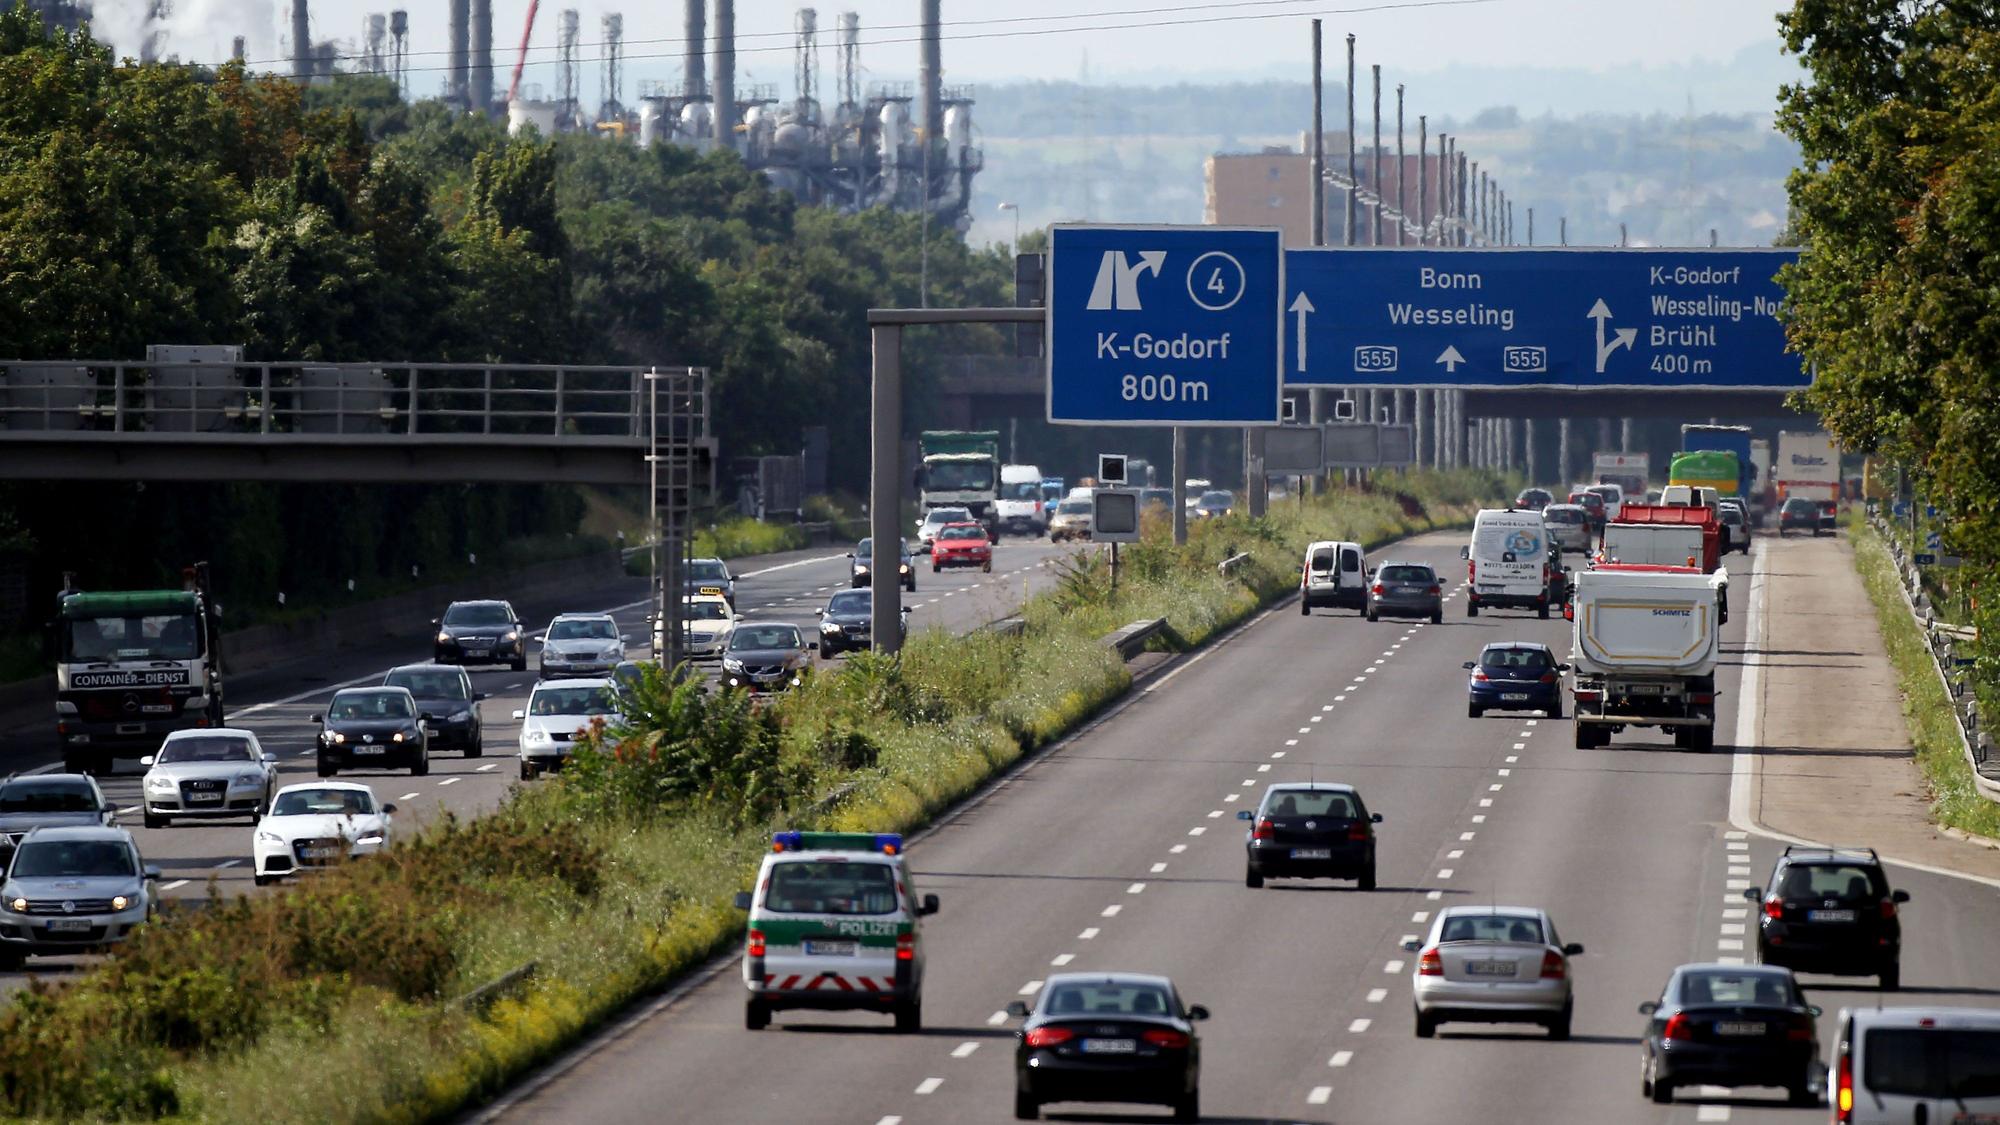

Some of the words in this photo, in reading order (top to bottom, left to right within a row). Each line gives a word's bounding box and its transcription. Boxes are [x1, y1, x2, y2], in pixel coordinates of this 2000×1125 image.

[1207, 267, 1225, 294] 4
[1421, 267, 1481, 289] Bonn
[1650, 266, 1740, 285] K-Godorf
[1388, 303, 1514, 331] Wesseling
[1097, 332, 1230, 359] K-Godorf
[1651, 325, 1716, 346] Brühl
[1360, 350, 1392, 368] 555
[1509, 350, 1541, 368] 555
[1652, 609, 1691, 617] SCHMITZ
[839, 921, 898, 936] POLIZEI
